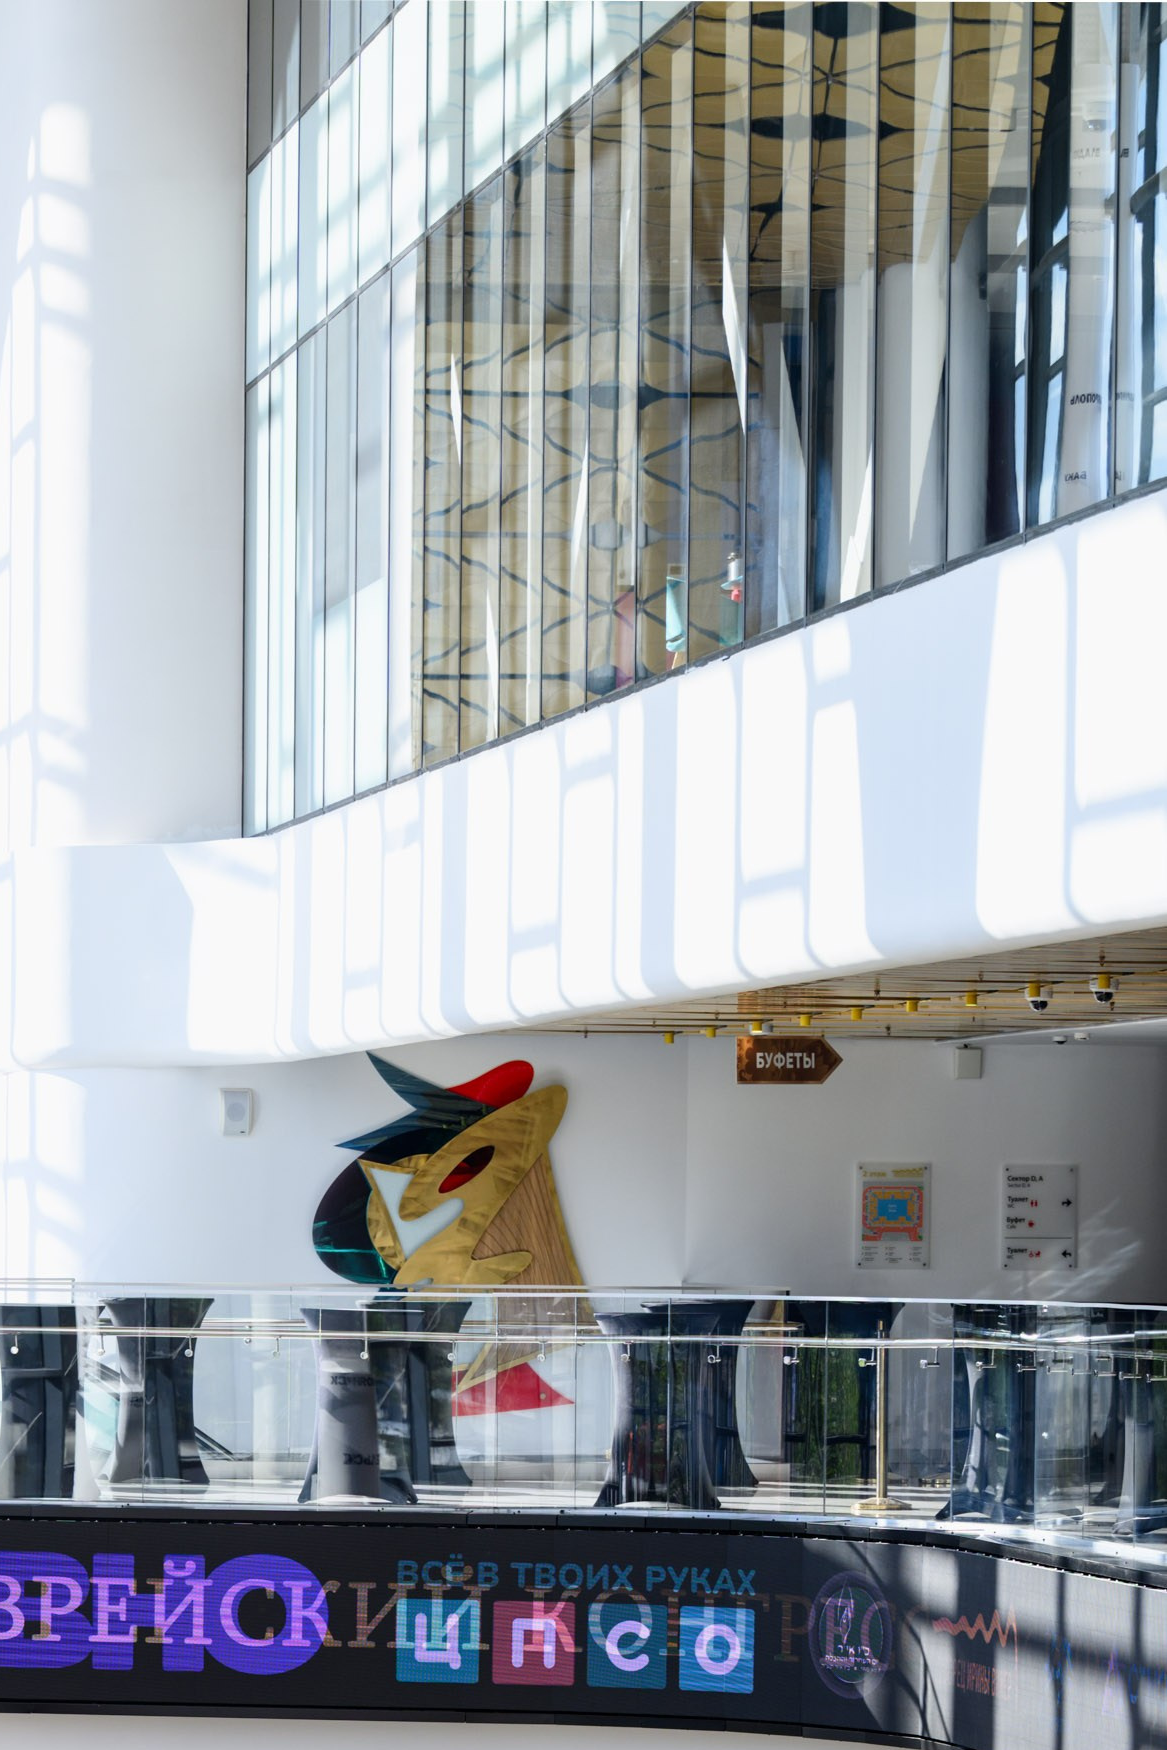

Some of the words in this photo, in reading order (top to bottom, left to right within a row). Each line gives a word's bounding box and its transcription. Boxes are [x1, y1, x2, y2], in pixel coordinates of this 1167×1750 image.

[756, 1052, 815, 1069] БУФЕТЫ
[1006, 1216, 1026, 1224] Буфет
[396, 1553, 465, 1587] ВСЁ
[478, 1561, 500, 1588] В
[510, 1561, 634, 1592] ТВОИХ
[646, 1565, 756, 1596] РУКАХ
